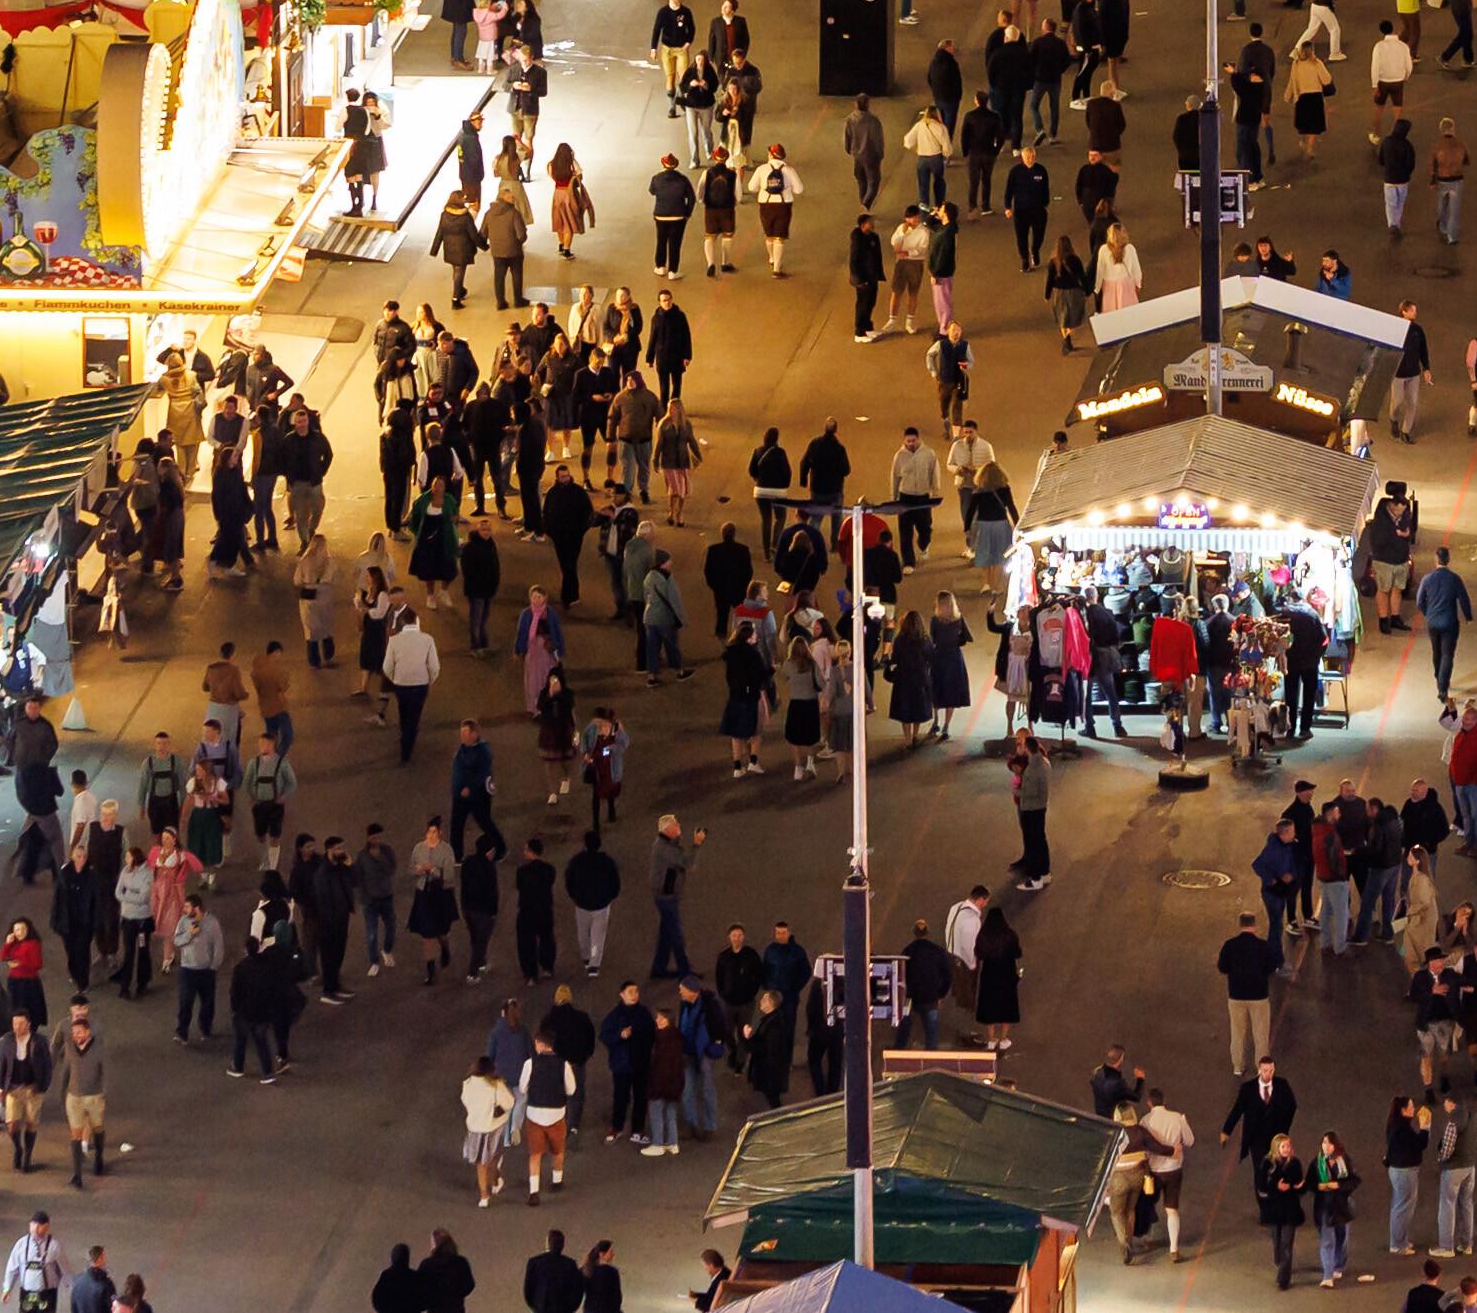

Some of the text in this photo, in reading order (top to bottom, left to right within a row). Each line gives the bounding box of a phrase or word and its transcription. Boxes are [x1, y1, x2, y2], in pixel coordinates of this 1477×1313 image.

[33, 298, 131, 310] Flammkuchen
[1173, 373, 1264, 389] Mandrennerei
[1077, 385, 1163, 421] Mandeln
[1276, 382, 1335, 417] Nüsse
